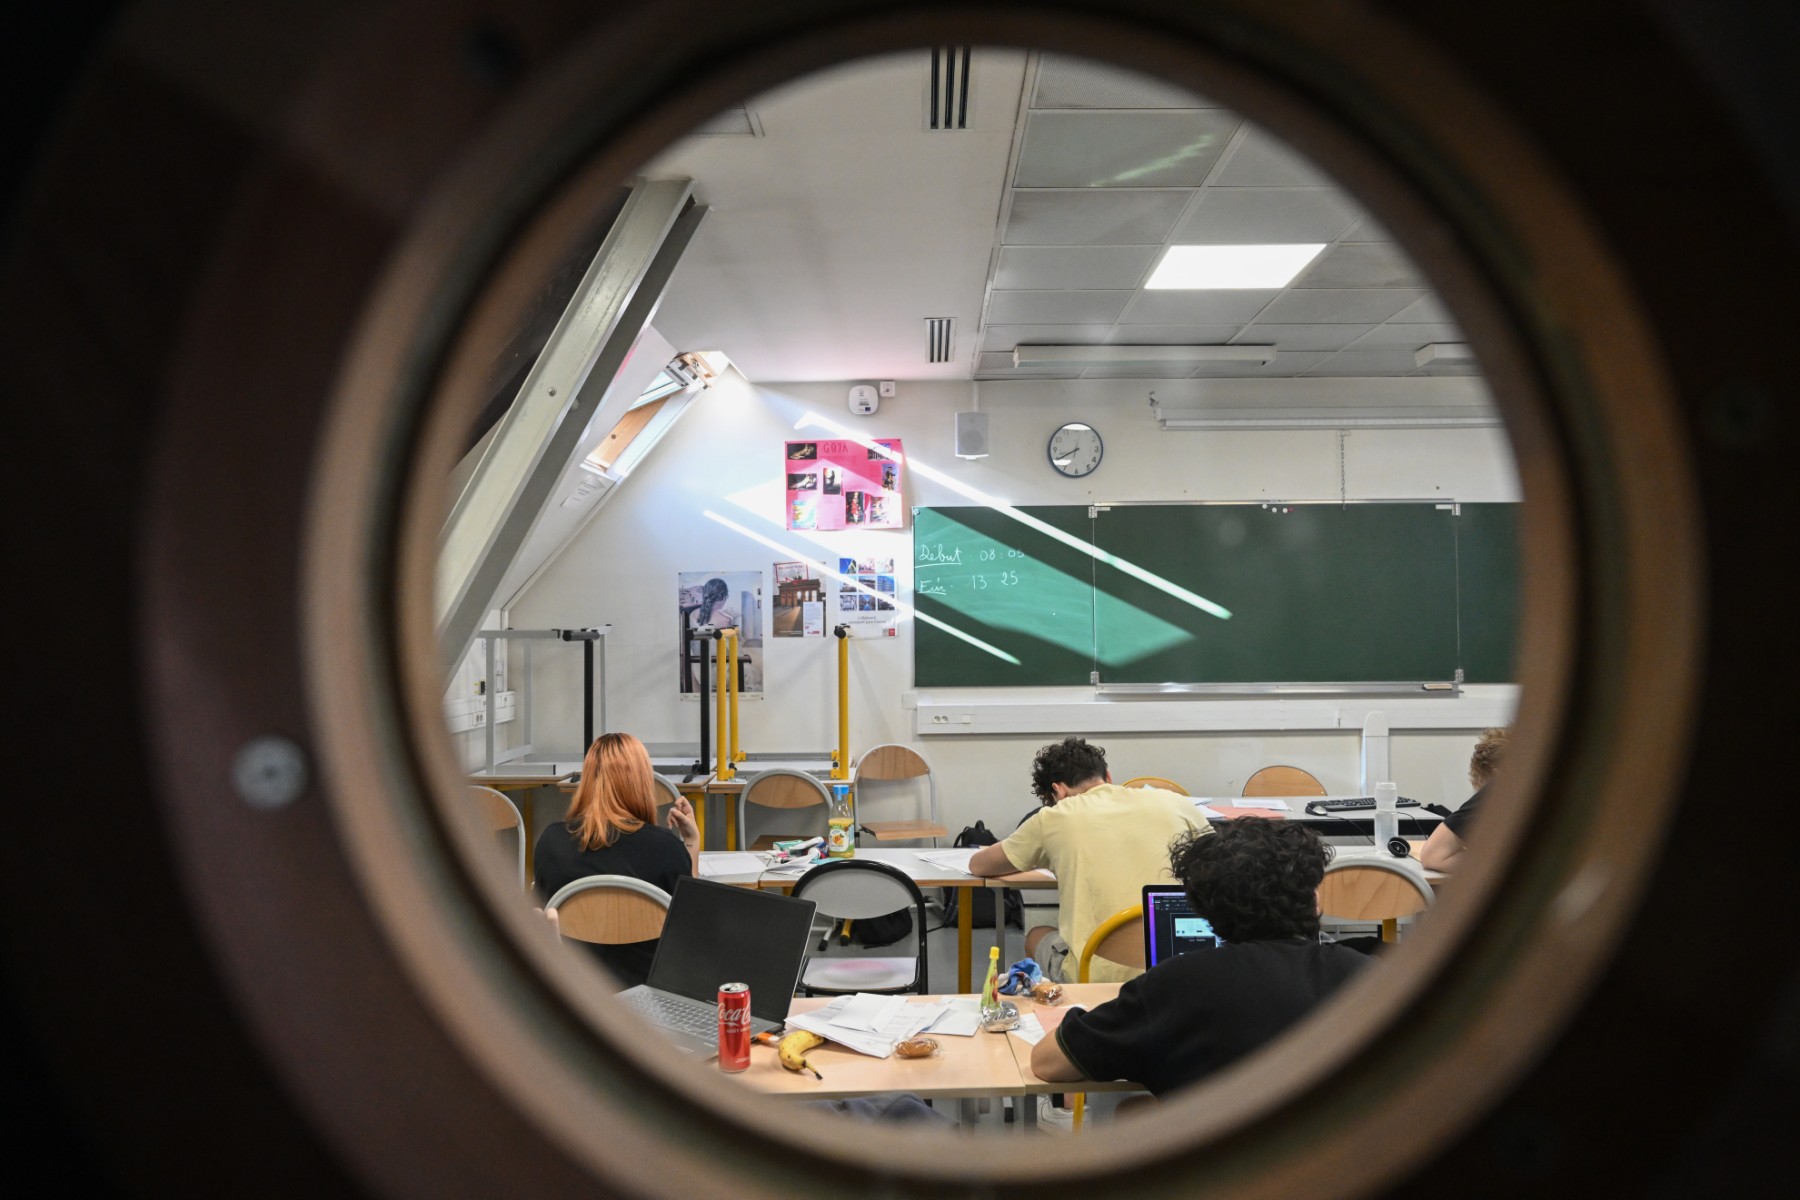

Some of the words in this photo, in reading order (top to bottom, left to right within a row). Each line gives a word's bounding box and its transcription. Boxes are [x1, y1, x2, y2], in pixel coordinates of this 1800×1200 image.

[823, 441, 848, 453] GOYA
[919, 544, 962, 562] Début
[970, 575, 987, 590] 13
[1001, 571, 1018, 585] 25
